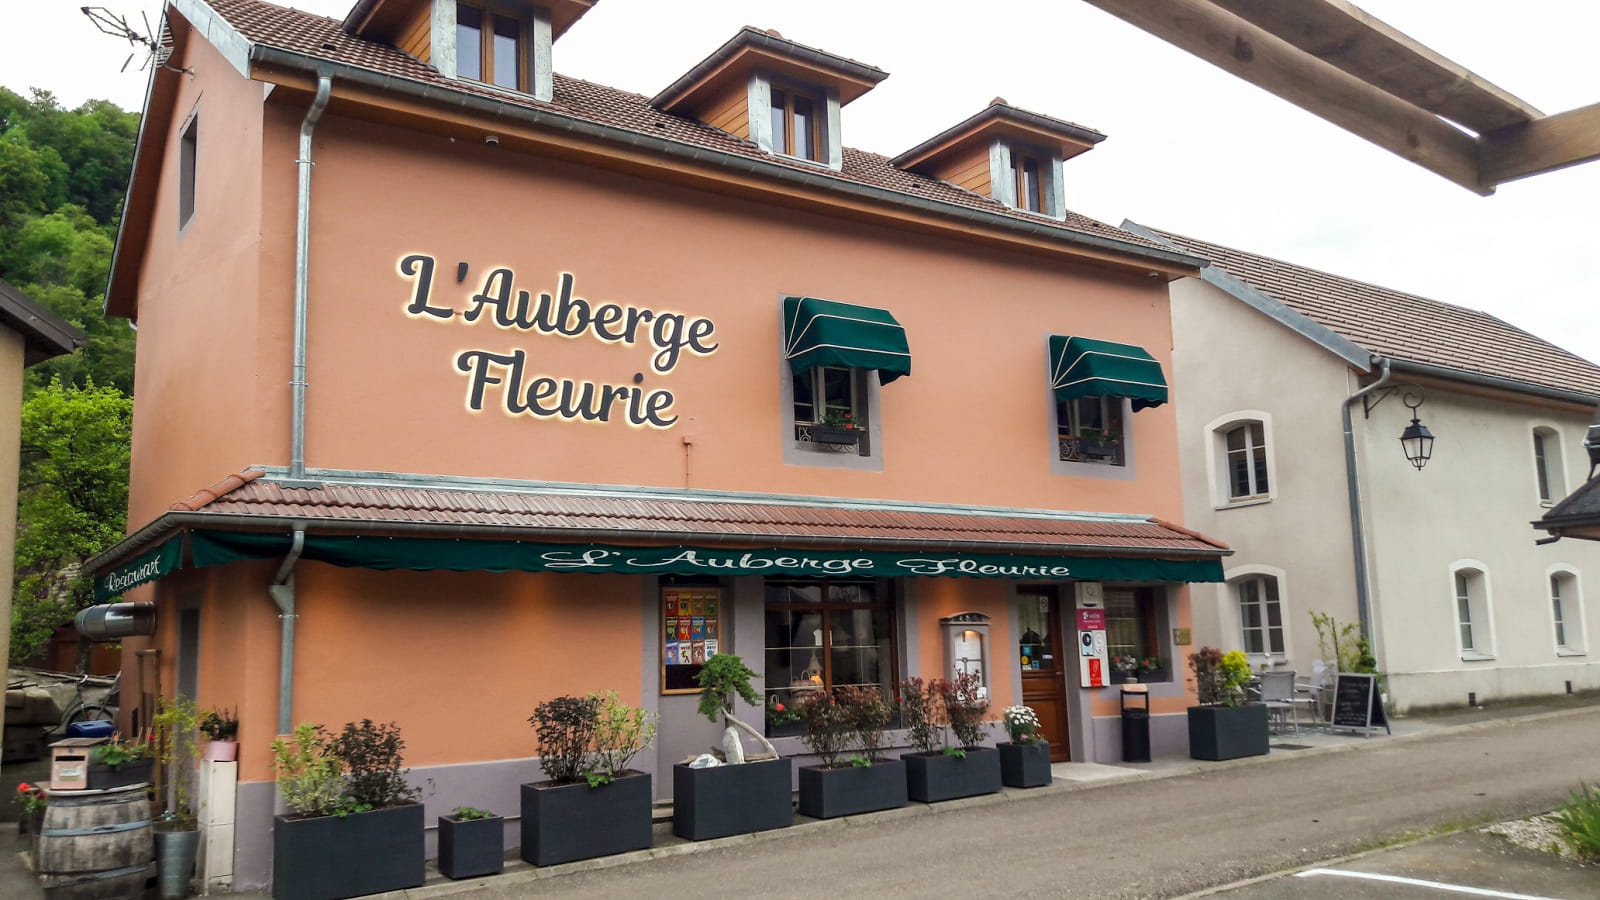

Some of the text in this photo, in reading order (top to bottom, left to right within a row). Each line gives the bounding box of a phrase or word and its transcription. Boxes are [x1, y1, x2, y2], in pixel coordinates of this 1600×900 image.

[400, 254, 719, 372] L'Auberge
[457, 350, 678, 426] Fleurie
[896, 557, 1070, 576] Fleurie
